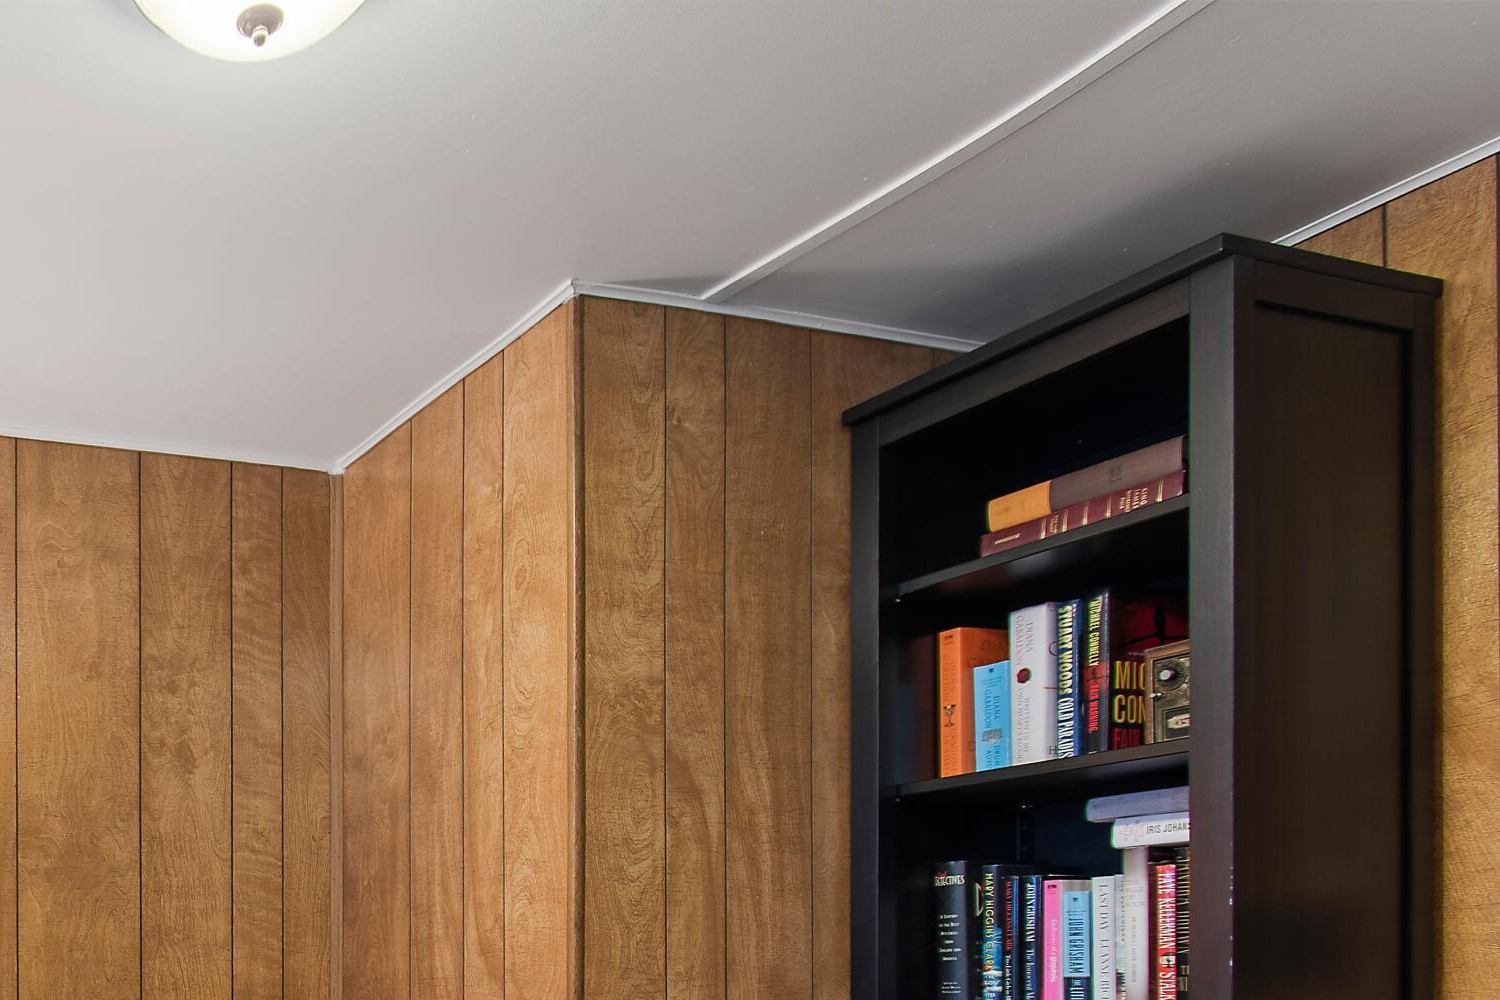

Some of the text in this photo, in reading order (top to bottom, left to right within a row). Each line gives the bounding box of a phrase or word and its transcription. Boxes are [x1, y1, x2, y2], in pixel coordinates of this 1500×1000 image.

[1089, 597, 1102, 631] MICHAEL
[1088, 632, 1101, 667] CONNELLY
[1058, 605, 1074, 760] STUART WOODS COLD PARADIS
[1146, 824, 1162, 834] IRIS
[1163, 821, 1190, 833] JOHAN
[985, 873, 995, 897] MARY
[1026, 883, 1036, 904] JOHN
[1099, 883, 1109, 911] LAST
[1159, 873, 1176, 895] FAYE
[985, 900, 995, 938] HIGGINS
[1026, 904, 1036, 942] GRISHAM
[1068, 917, 1084, 937] JOHN
[1099, 911, 1109, 932] DAY
[1159, 898, 1176, 949] KELLERMAN
[1068, 938, 1084, 974] GRISHAM
[1100, 939, 1110, 978] LUANNE
